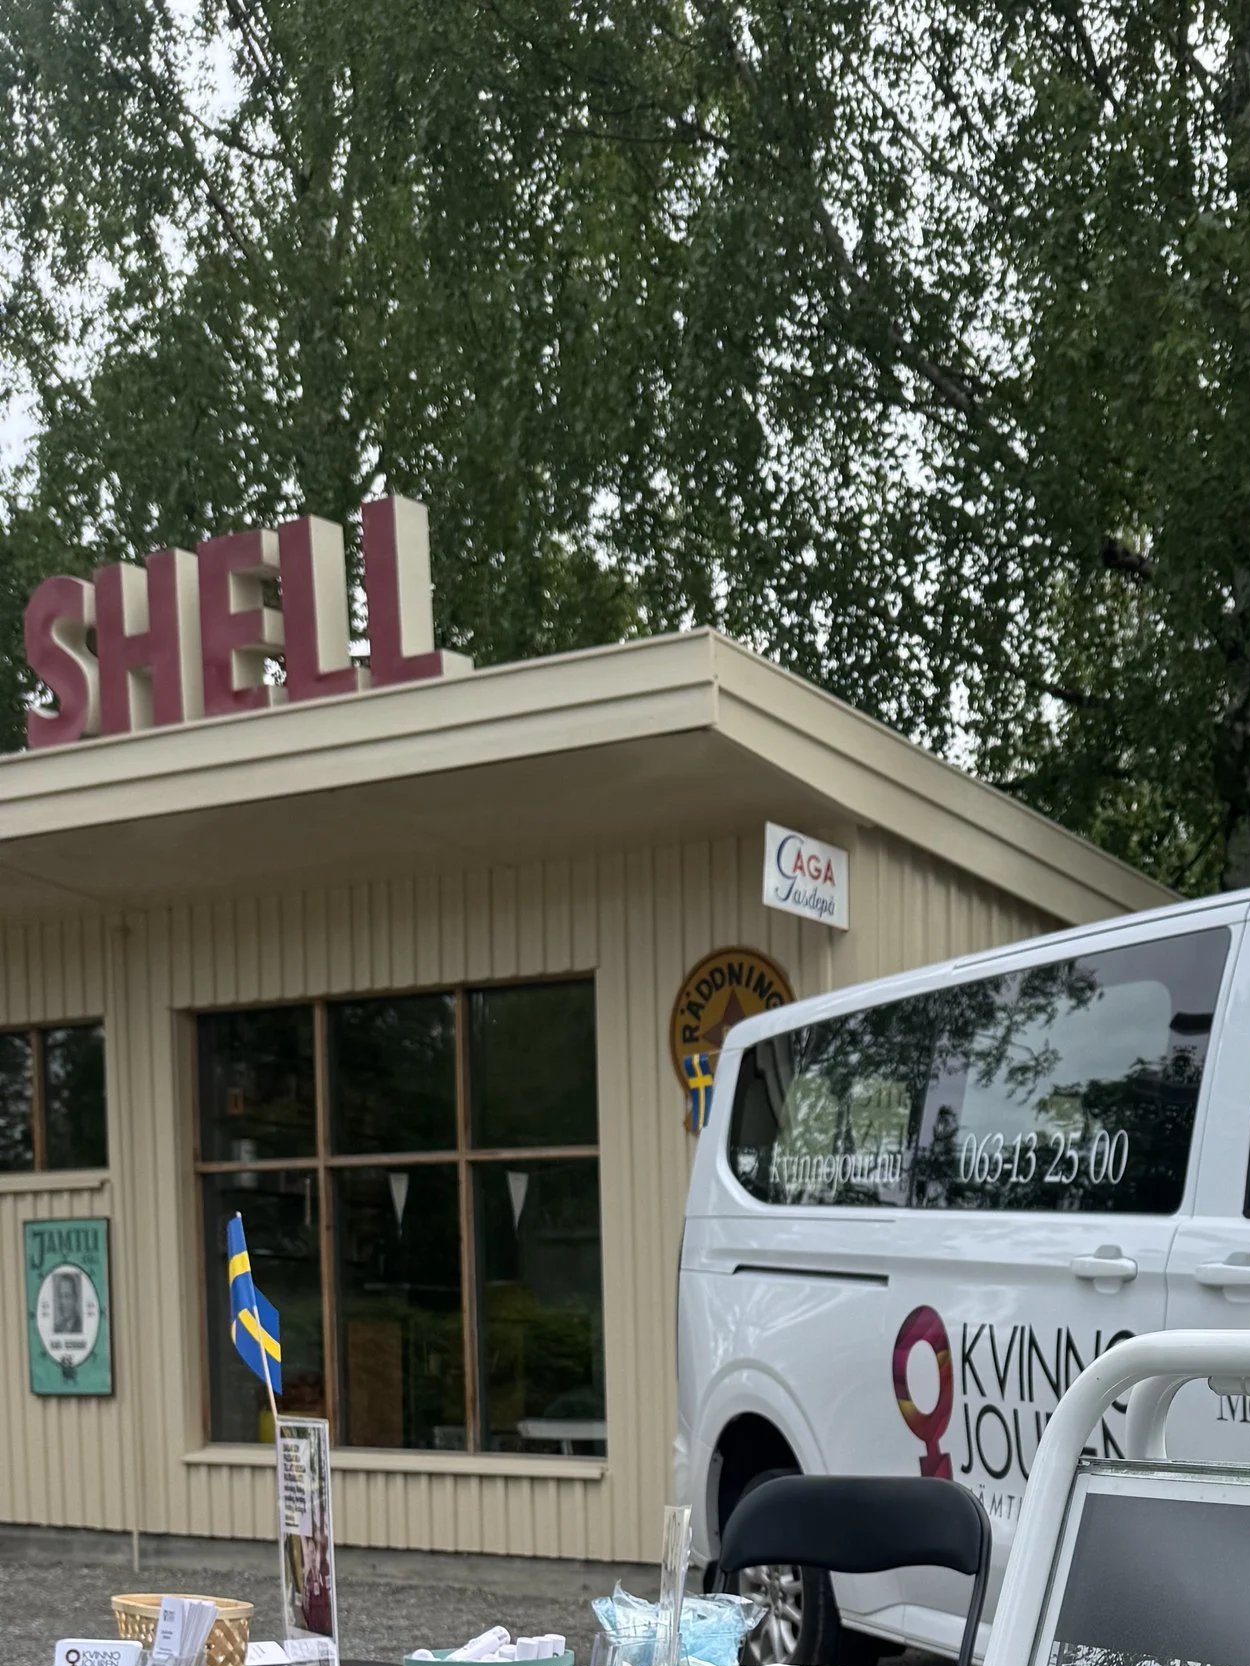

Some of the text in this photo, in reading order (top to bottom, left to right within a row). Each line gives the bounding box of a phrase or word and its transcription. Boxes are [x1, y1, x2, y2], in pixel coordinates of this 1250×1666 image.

[24, 495, 474, 748] SHELL
[791, 847, 836, 887] AGA
[960, 1129, 1129, 1184] 063-13 25 00
[82, 1650, 121, 1661] KVINNO
